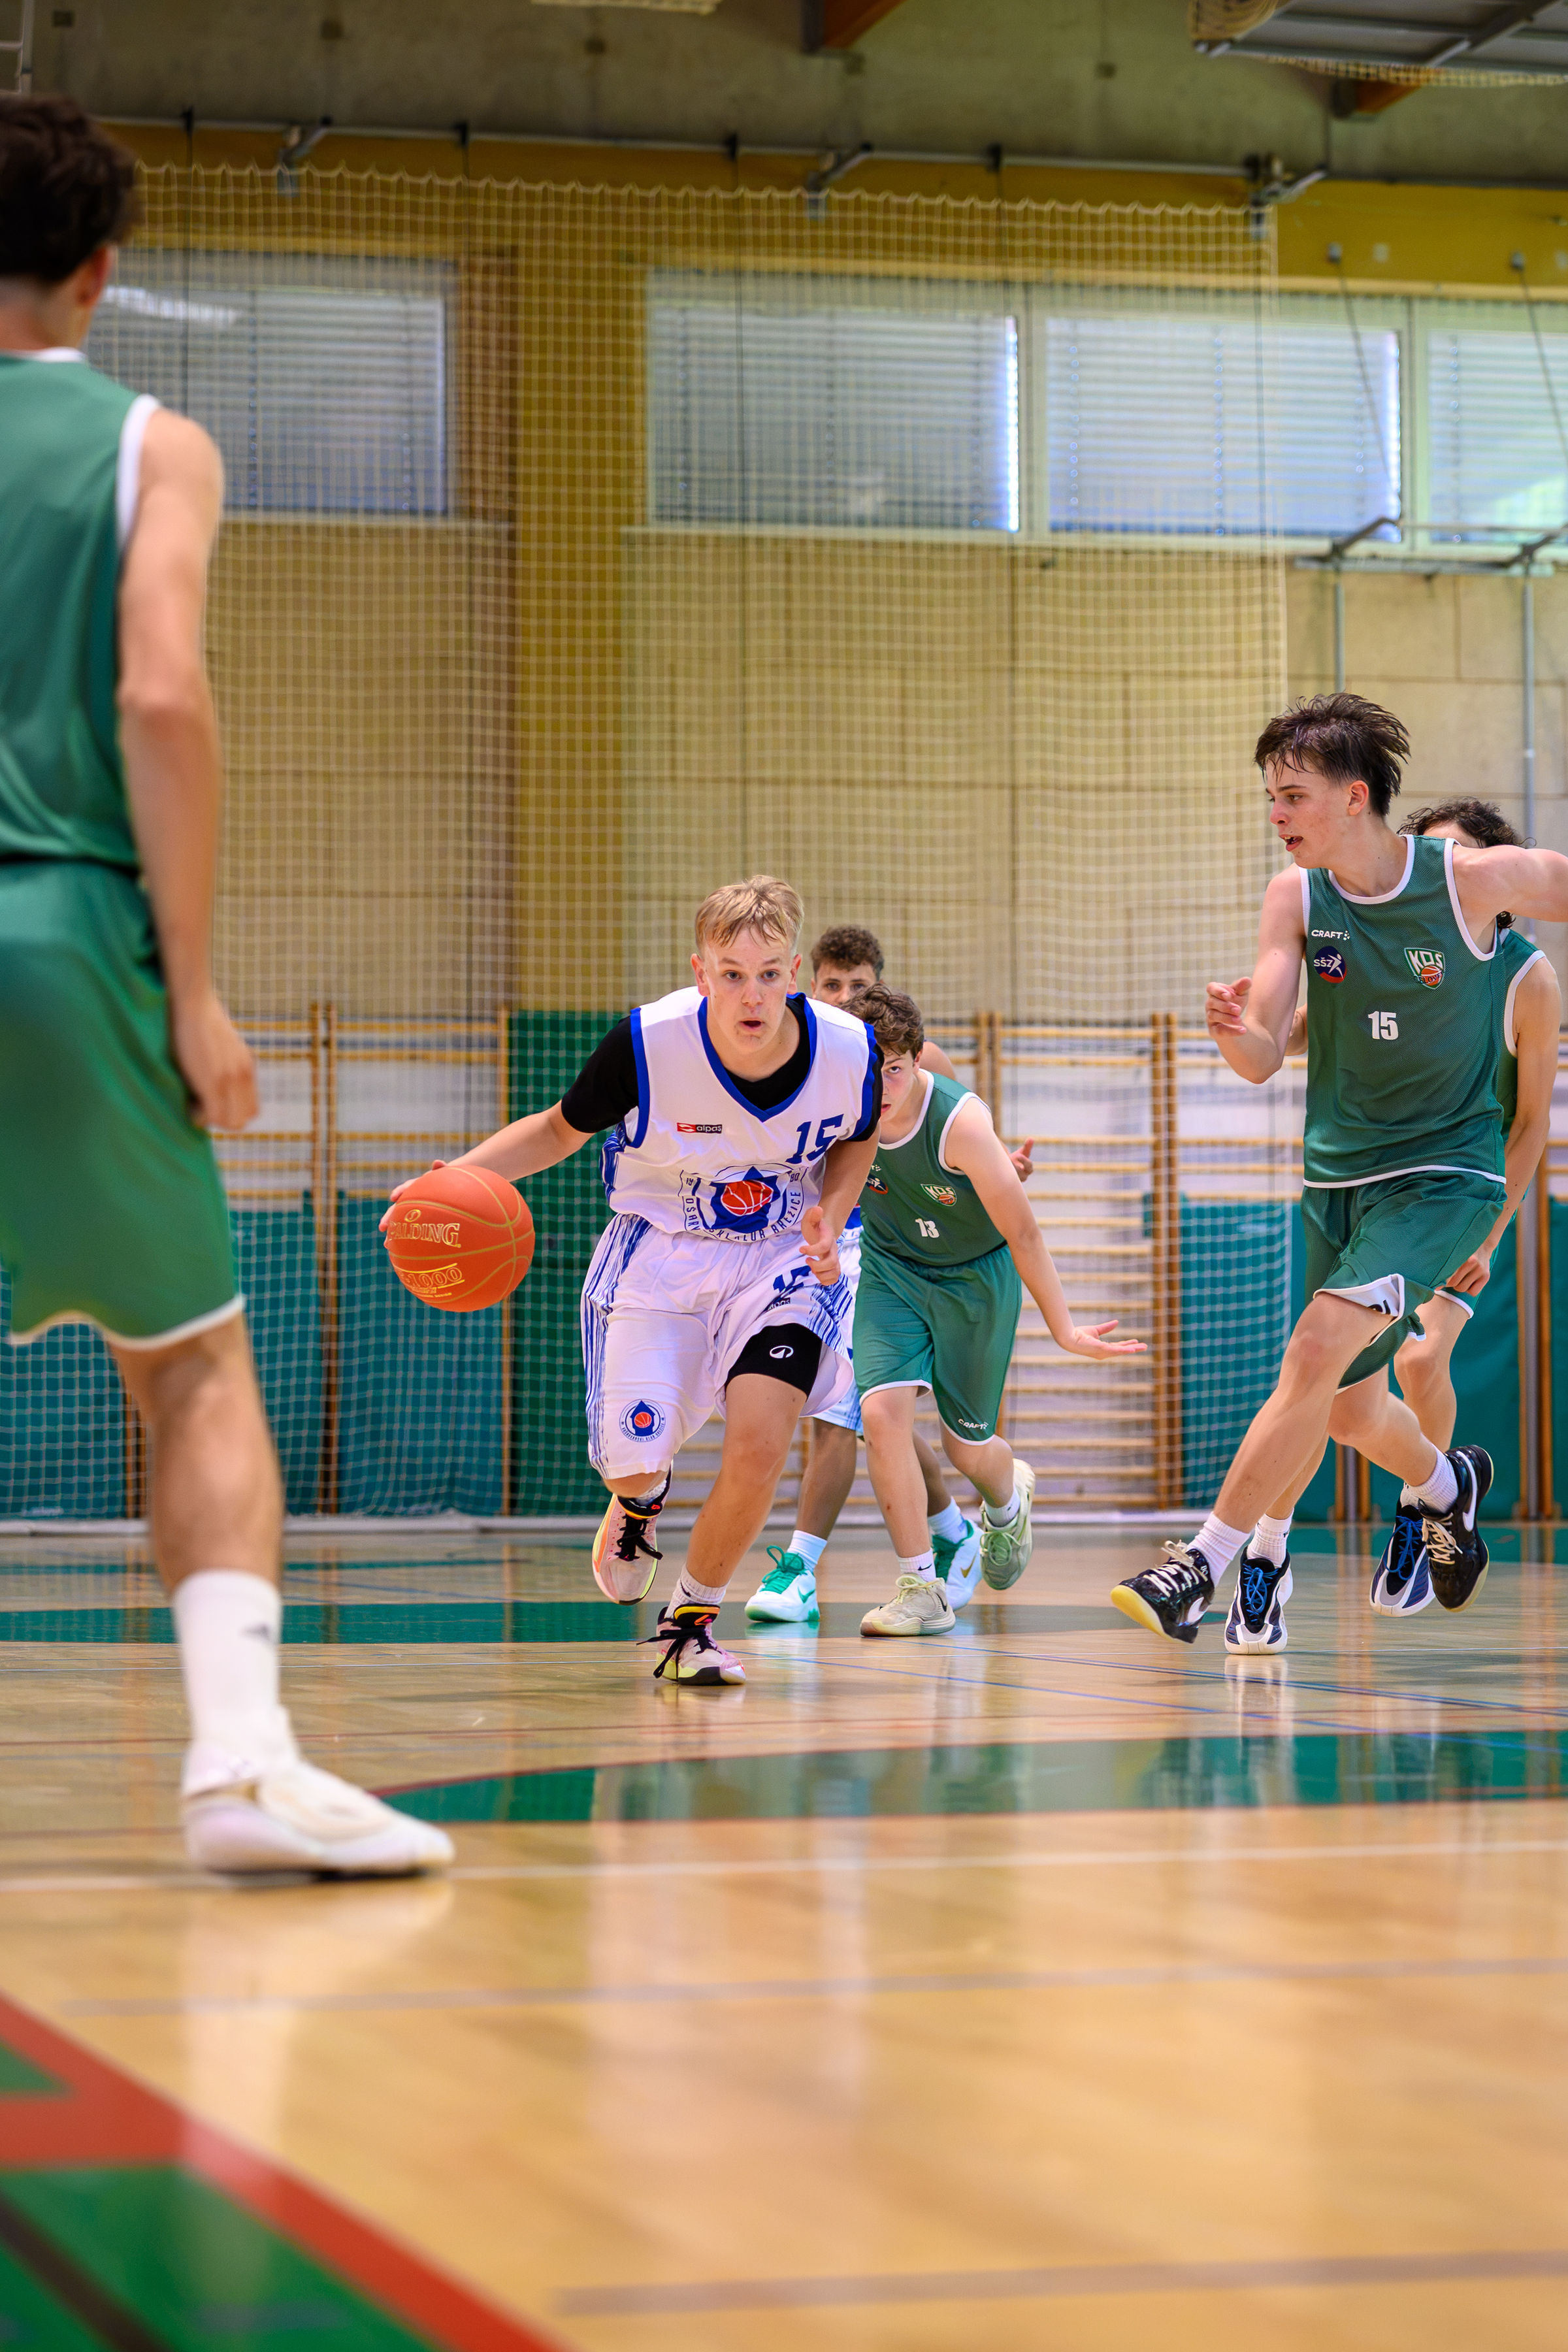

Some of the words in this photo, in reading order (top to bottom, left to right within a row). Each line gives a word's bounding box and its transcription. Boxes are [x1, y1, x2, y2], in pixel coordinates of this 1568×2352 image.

[1311, 929, 1344, 939] CRAFT
[1367, 1011, 1399, 1040] 15
[785, 1113, 844, 1164] 15
[915, 1218, 940, 1238] 13
[958, 1418, 985, 1429] CRAFT
